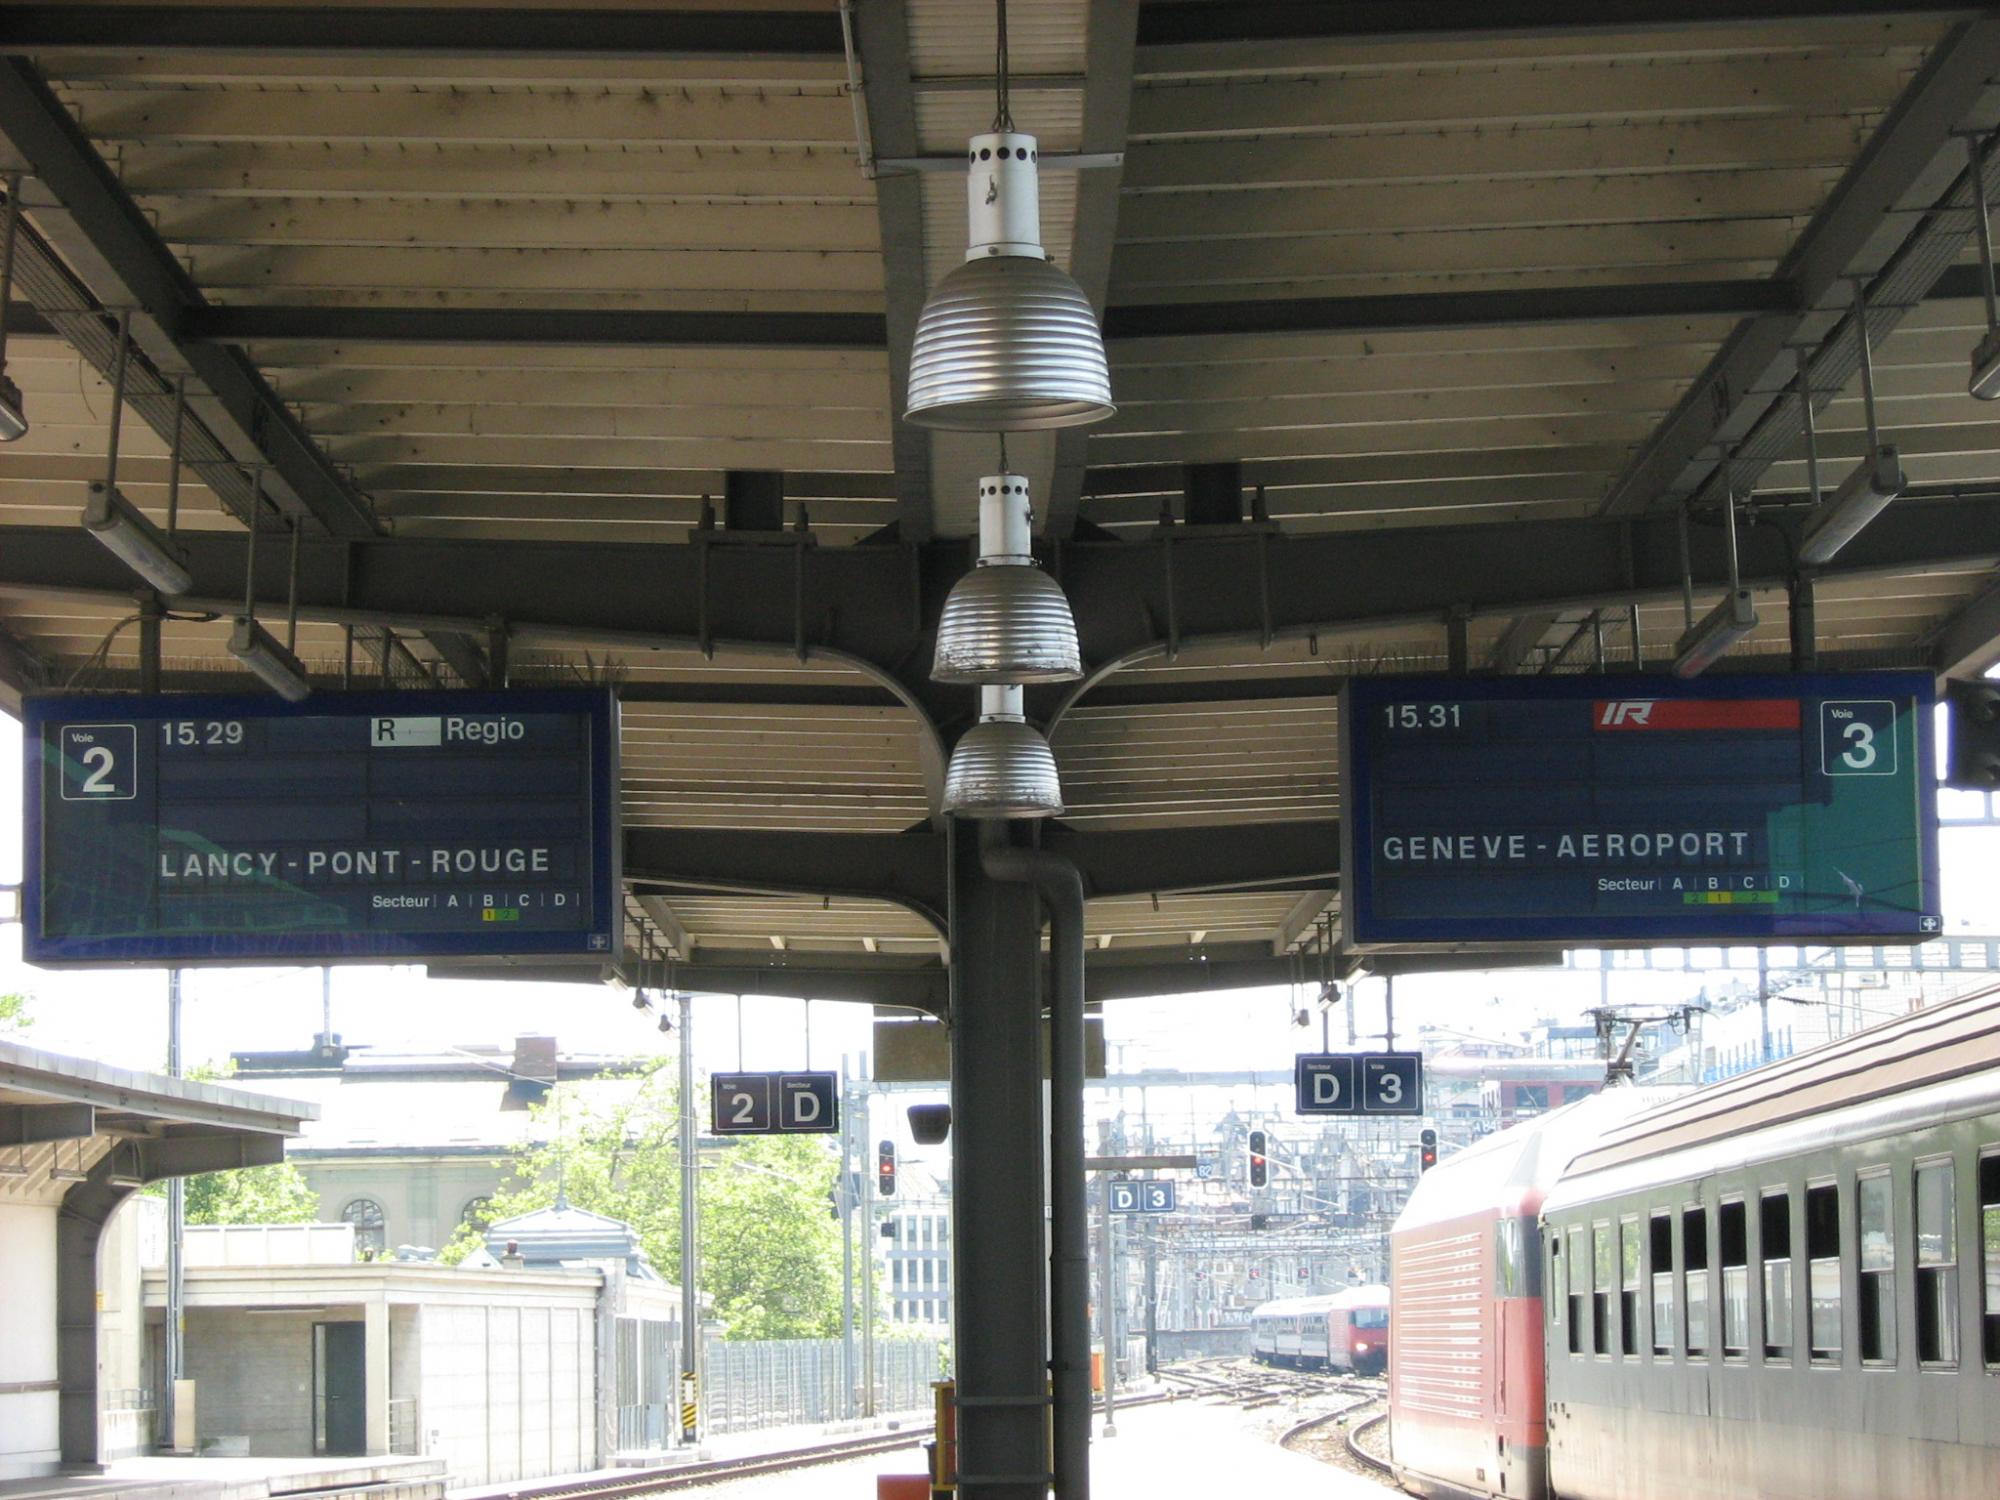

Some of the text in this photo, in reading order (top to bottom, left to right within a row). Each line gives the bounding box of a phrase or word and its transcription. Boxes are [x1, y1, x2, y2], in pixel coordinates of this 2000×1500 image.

[1384, 704, 1462, 729] 15.31
[1600, 701, 1654, 725] IR
[1831, 709, 1854, 719] Voie
[72, 733, 94, 743] Voie
[162, 721, 243, 746] 15.29
[377, 717, 525, 745] R Regio
[1842, 722, 1878, 768] 3
[82, 747, 115, 793] 2
[1598, 876, 1790, 891] Secteur A B C D
[372, 893, 566, 908] Secteur A B C D
[503, 910, 511, 920] 2
[1314, 1073, 1403, 1104] D 3
[731, 1091, 820, 1123] 2 D
[1118, 1190, 1166, 1208] D 3
